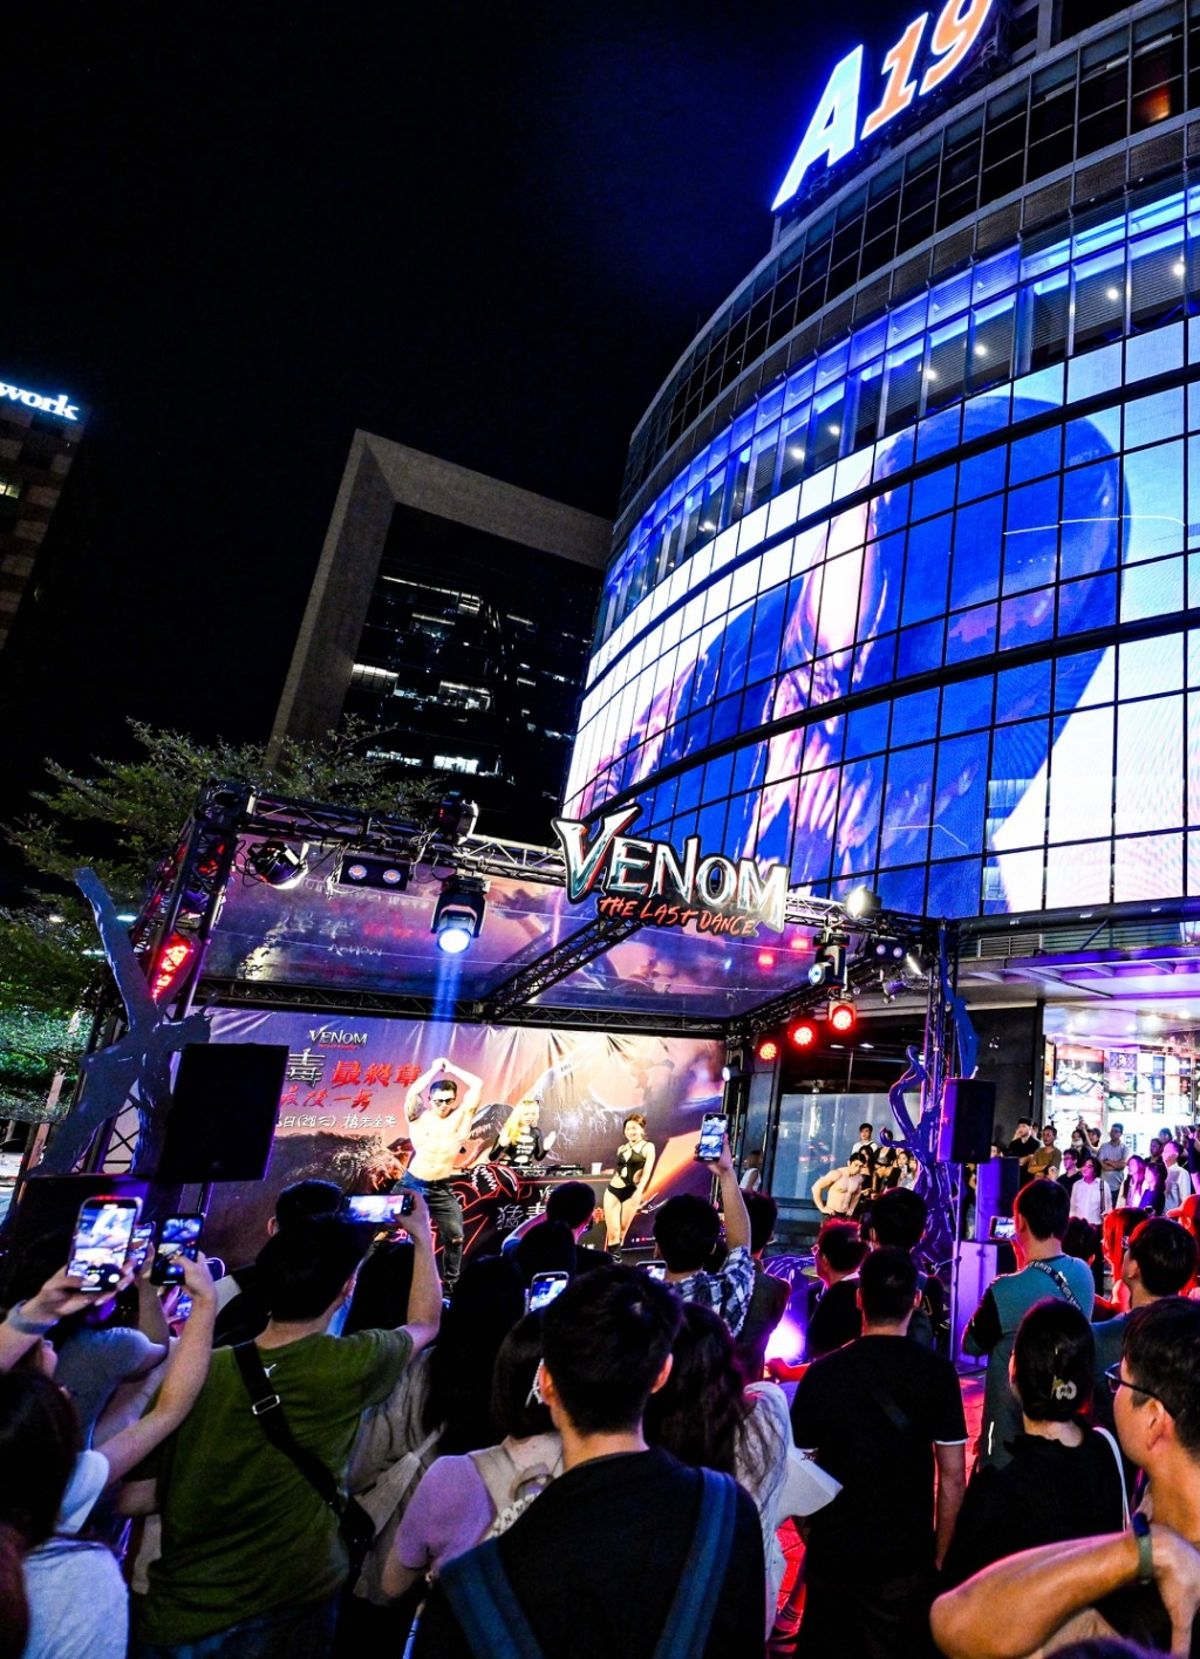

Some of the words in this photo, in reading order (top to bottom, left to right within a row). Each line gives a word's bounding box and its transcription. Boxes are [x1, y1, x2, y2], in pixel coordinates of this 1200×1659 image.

[770, 0, 992, 211] A19
[553, 805, 788, 931] VENOM
[640, 901, 698, 925] LAST
[698, 910, 756, 936] DANCE
[309, 1024, 369, 1045] VENOM
